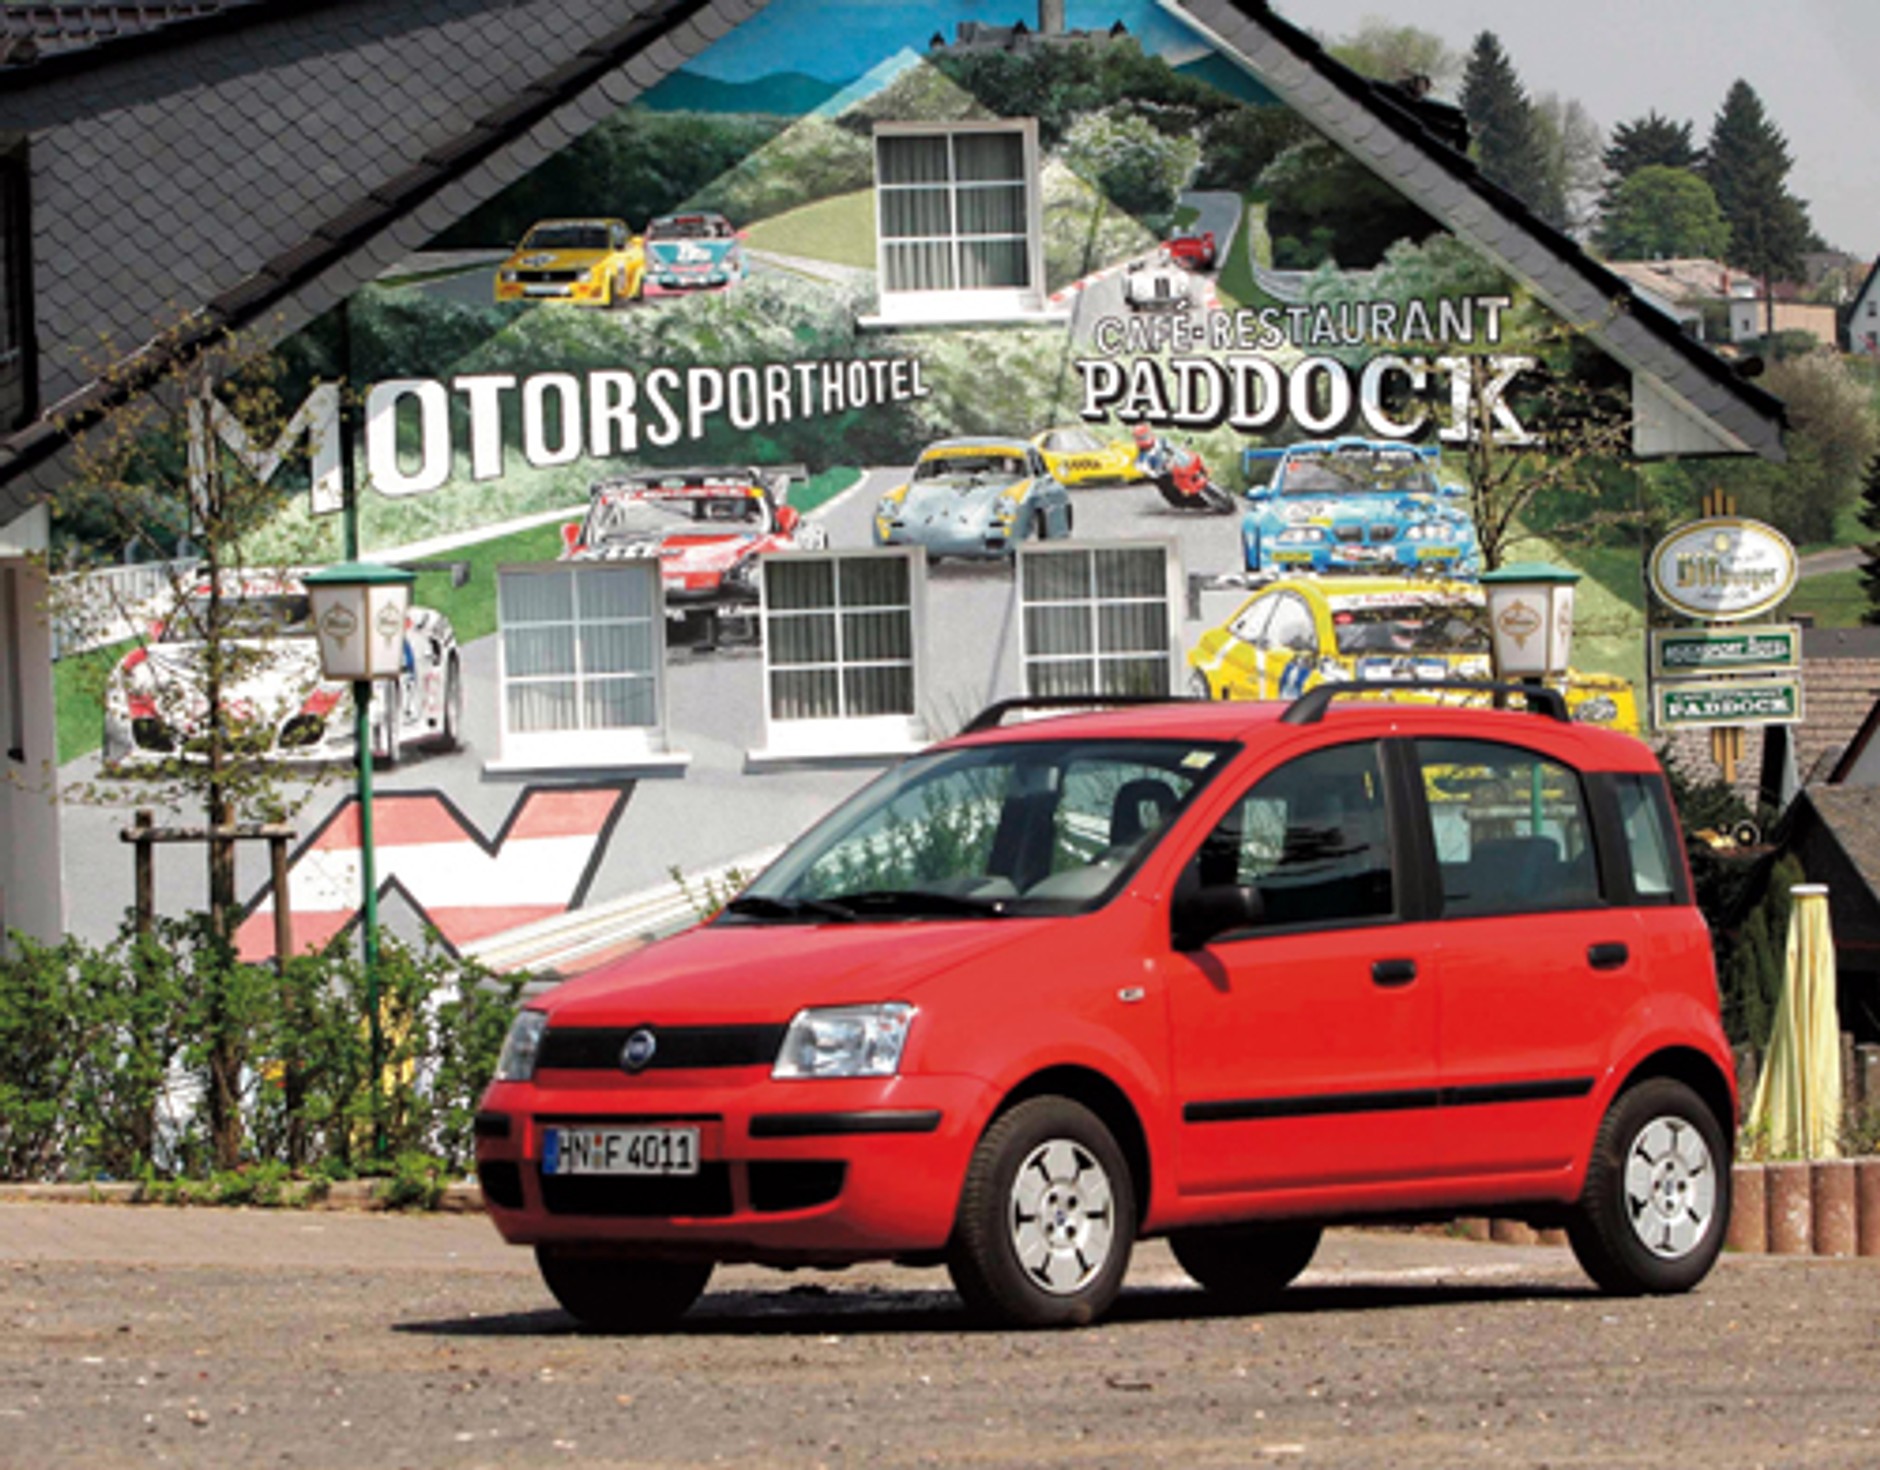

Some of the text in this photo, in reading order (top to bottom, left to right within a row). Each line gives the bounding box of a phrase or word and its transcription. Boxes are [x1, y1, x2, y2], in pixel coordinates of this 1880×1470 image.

[1076, 355, 1546, 448] PADDOCK
[558, 1133, 693, 1169] HN F 4011
